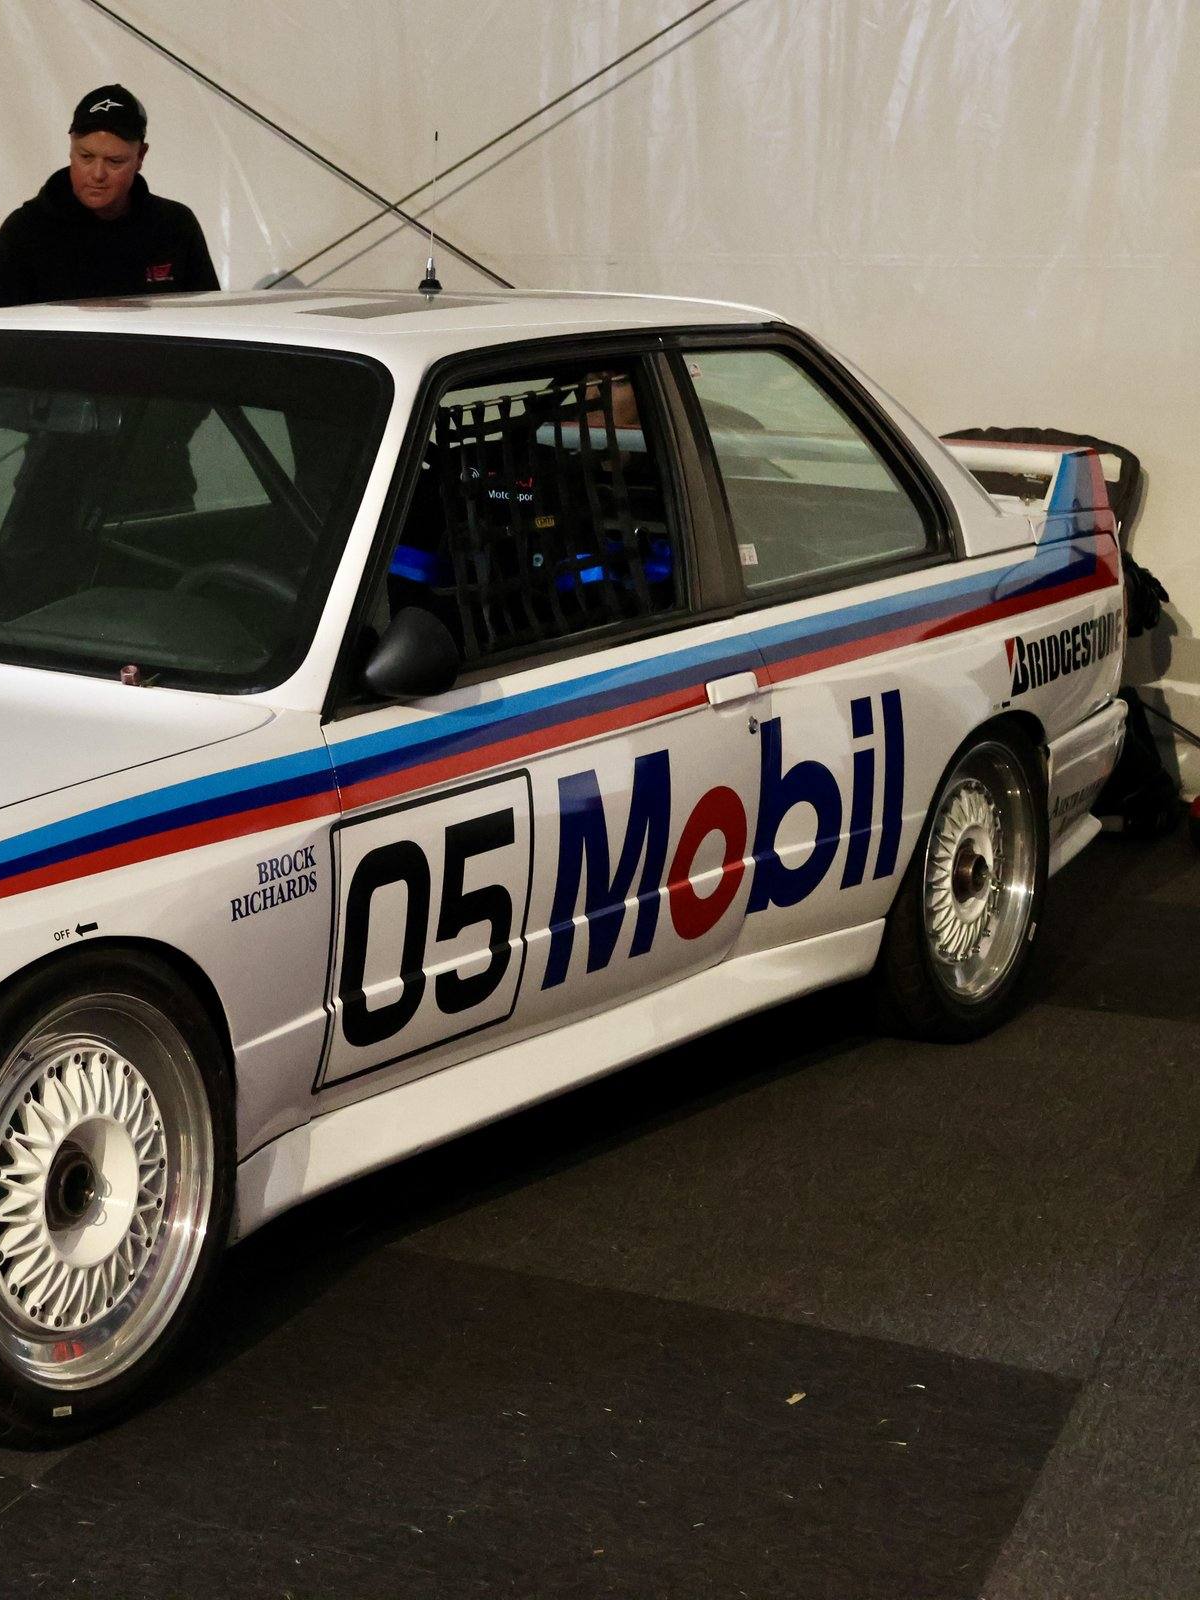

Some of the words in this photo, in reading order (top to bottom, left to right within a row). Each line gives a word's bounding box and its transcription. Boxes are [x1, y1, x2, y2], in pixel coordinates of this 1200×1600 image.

[1005, 609, 1122, 697] BRIDGESTONE
[256, 844, 318, 886] BROCK
[541, 689, 905, 992] Mobil
[230, 870, 318, 922] RICHARDS
[341, 807, 515, 1048] 05
[53, 928, 71, 942] OFF
